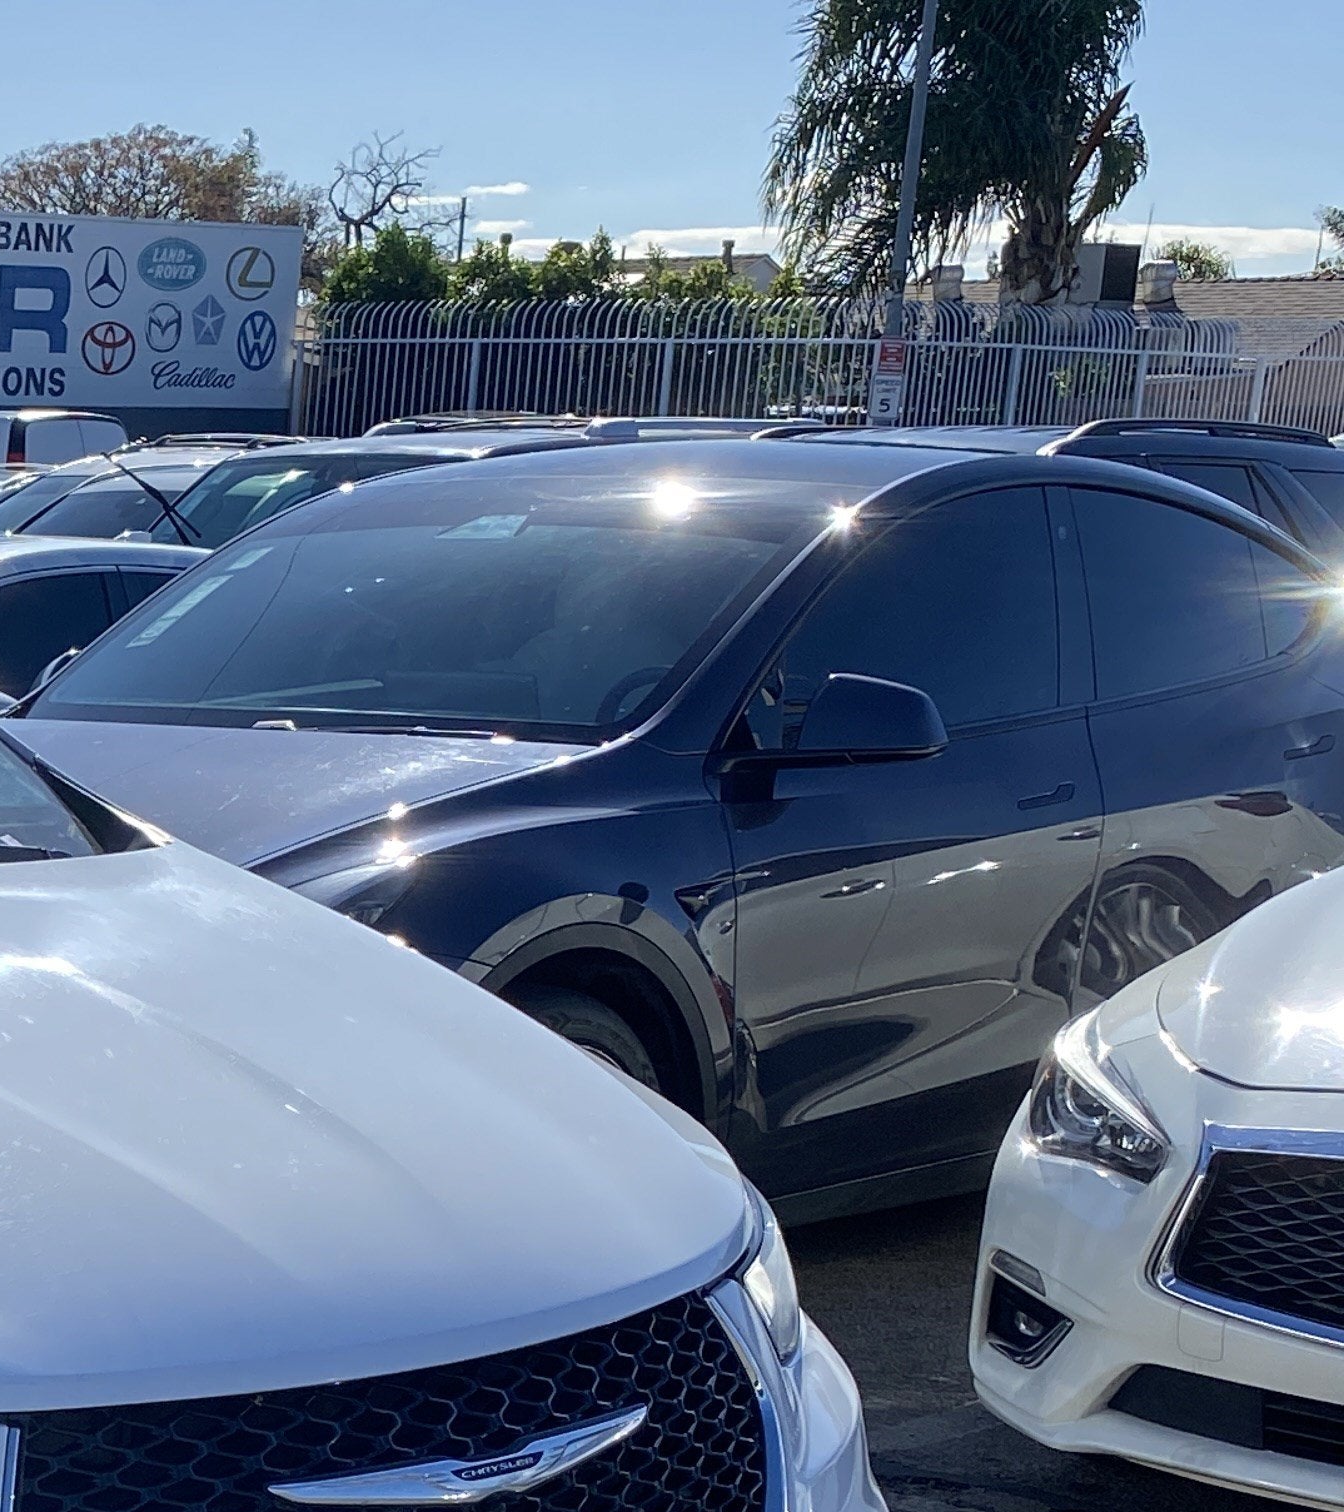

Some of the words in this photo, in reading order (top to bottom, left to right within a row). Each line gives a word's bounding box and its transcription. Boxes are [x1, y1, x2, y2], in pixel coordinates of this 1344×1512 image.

[150, 360, 236, 390] Cadillac
[878, 398, 891, 413] 5
[460, 1455, 535, 1481] CHRYSLER
